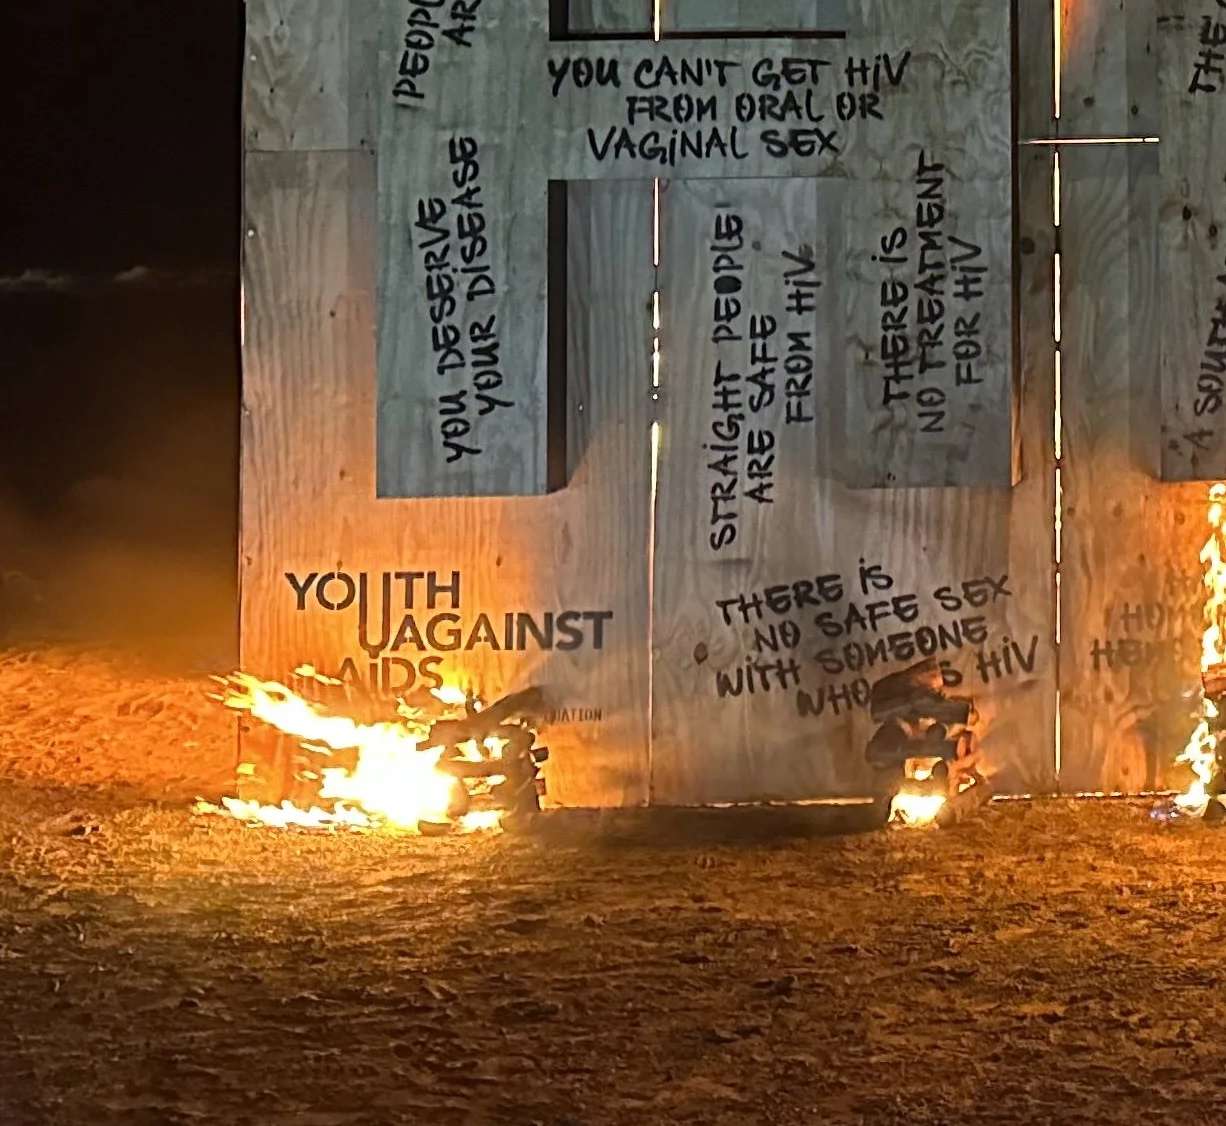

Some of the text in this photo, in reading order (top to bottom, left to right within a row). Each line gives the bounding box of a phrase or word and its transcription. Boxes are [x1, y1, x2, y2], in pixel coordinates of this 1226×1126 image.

[548, 56, 621, 97] YOU
[633, 55, 742, 90] CAN'T
[752, 57, 832, 91] GET
[626, 89, 884, 125] FROM ORAL OR
[760, 128, 839, 158] SEX
[710, 214, 744, 344] PEOPLE
[914, 149, 946, 433] NO TREATMENT
[415, 198, 482, 463] YOU DESERVE
[470, 314, 515, 416] YOUR
[881, 281, 914, 406] THERE
[952, 312, 984, 387] FOR
[743, 313, 778, 504] ARE SAFE
[785, 332, 814, 425] FROM
[1182, 428, 1214, 451] A
[285, 571, 460, 652] YOUTH
[390, 611, 613, 651] AGAINST
[716, 575, 843, 625] THERE
[754, 574, 1012, 653] NO SAFE SEX
[815, 616, 987, 674] SOMEONE
[796, 678, 872, 716] WHO
